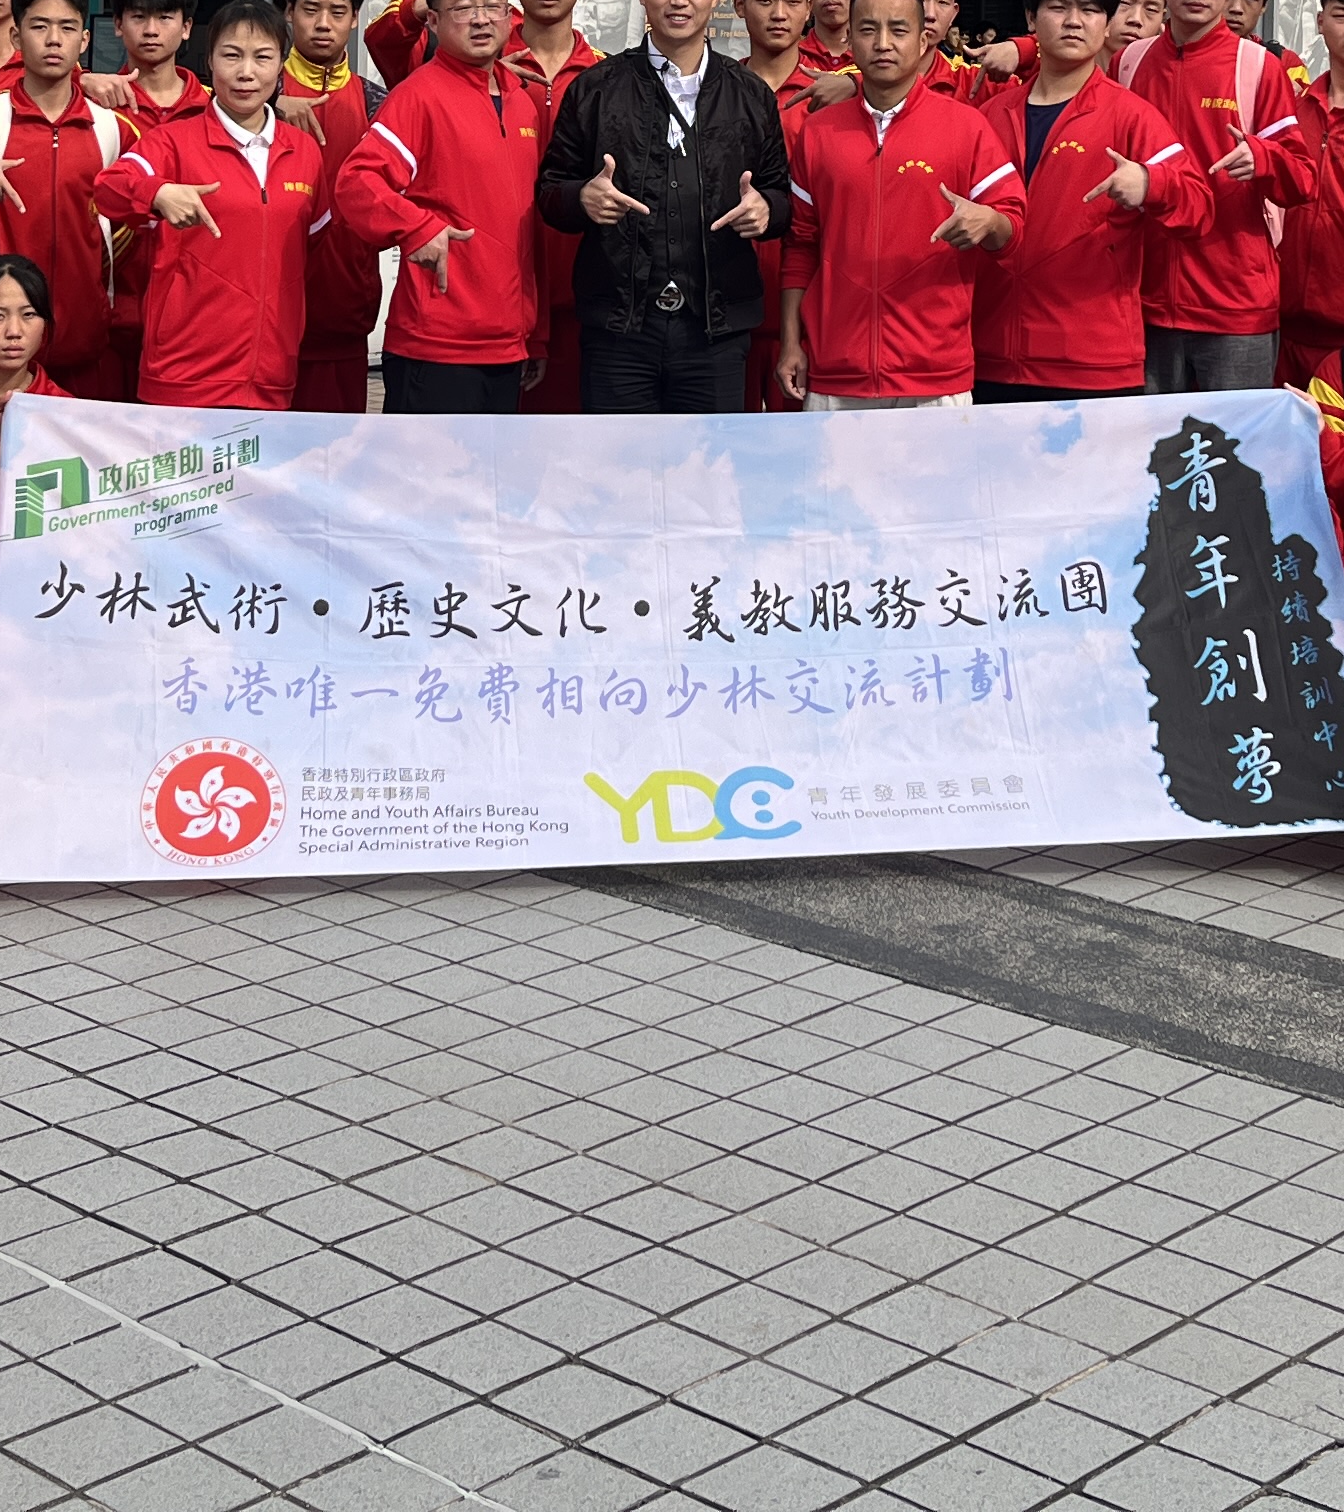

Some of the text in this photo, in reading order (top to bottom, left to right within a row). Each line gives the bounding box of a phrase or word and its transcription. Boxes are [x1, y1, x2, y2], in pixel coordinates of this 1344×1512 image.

[48, 475, 235, 532] Government-sponsored
[134, 503, 218, 535] programme
[1166, 432, 1282, 806] 青年創夢
[302, 767, 446, 783] 香港特別行政區政府
[301, 786, 430, 802] 民政及青年事務局
[807, 774, 1025, 806] 青年發展委員會
[300, 804, 539, 820] Home and Youth Affairs Bureau
[583, 765, 803, 844] YDC
[811, 798, 1031, 821] Youth Development Commission
[299, 819, 570, 838] The Government of the Hong Kong
[166, 847, 255, 866] HONG KONG
[298, 836, 529, 856] Special Administrative Region
